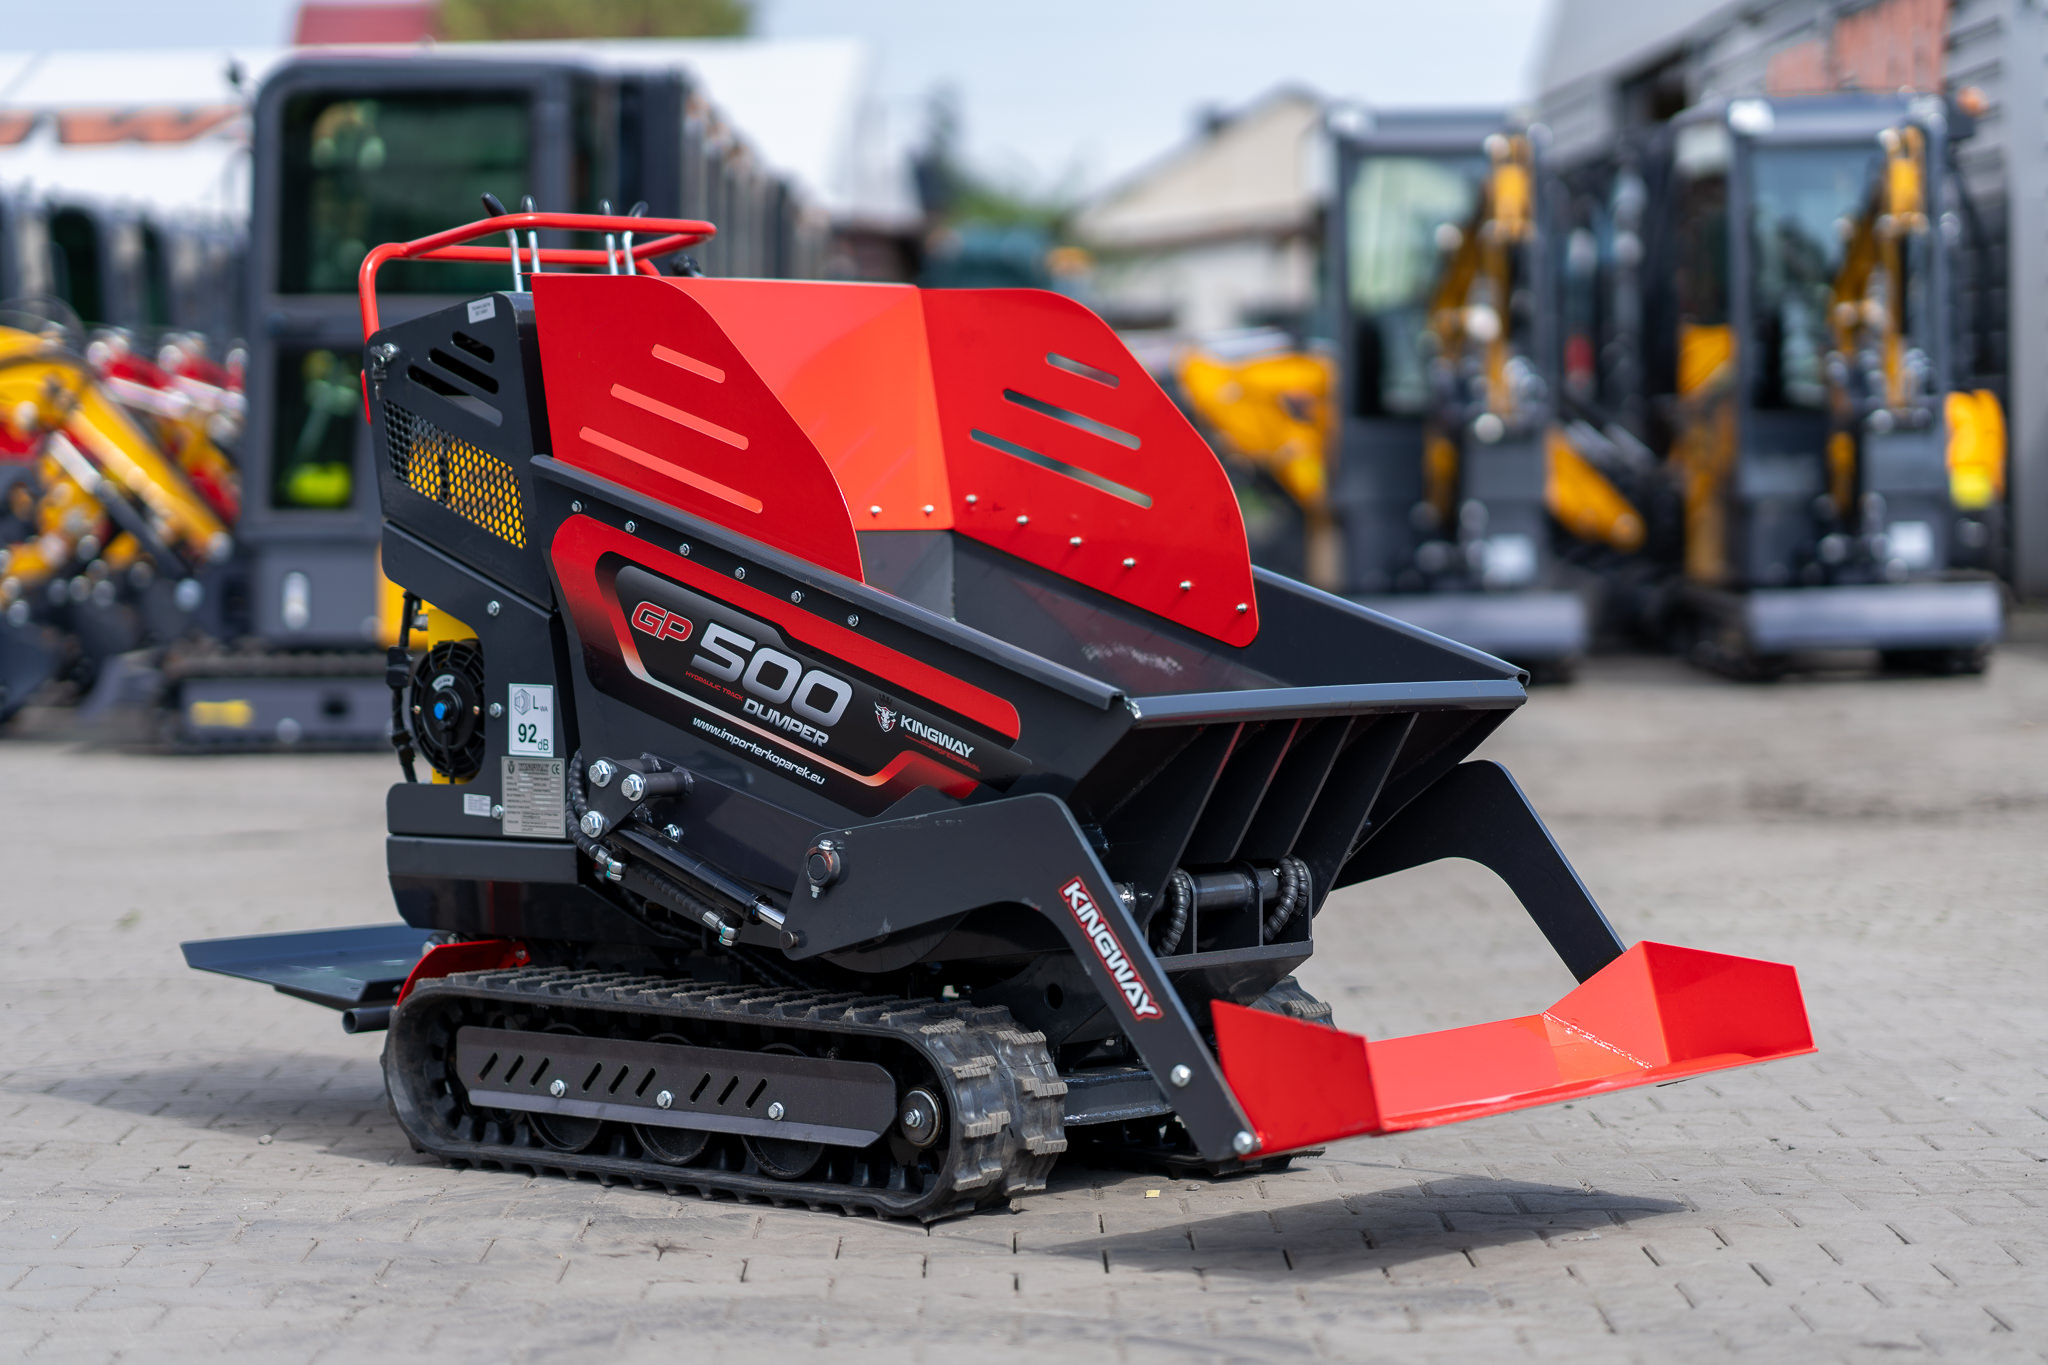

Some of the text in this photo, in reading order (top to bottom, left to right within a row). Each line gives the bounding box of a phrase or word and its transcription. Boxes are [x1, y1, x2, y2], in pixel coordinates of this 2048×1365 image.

[631, 601, 853, 727] GP 500
[518, 723, 549, 751] 92 dB
[685, 670, 829, 746] HYDRAULIC TRACK DUMPER
[900, 714, 975, 758] KINGWAY
[692, 717, 826, 785] www.importerkoparek.eu
[1063, 881, 1158, 1015] KINGWAY
